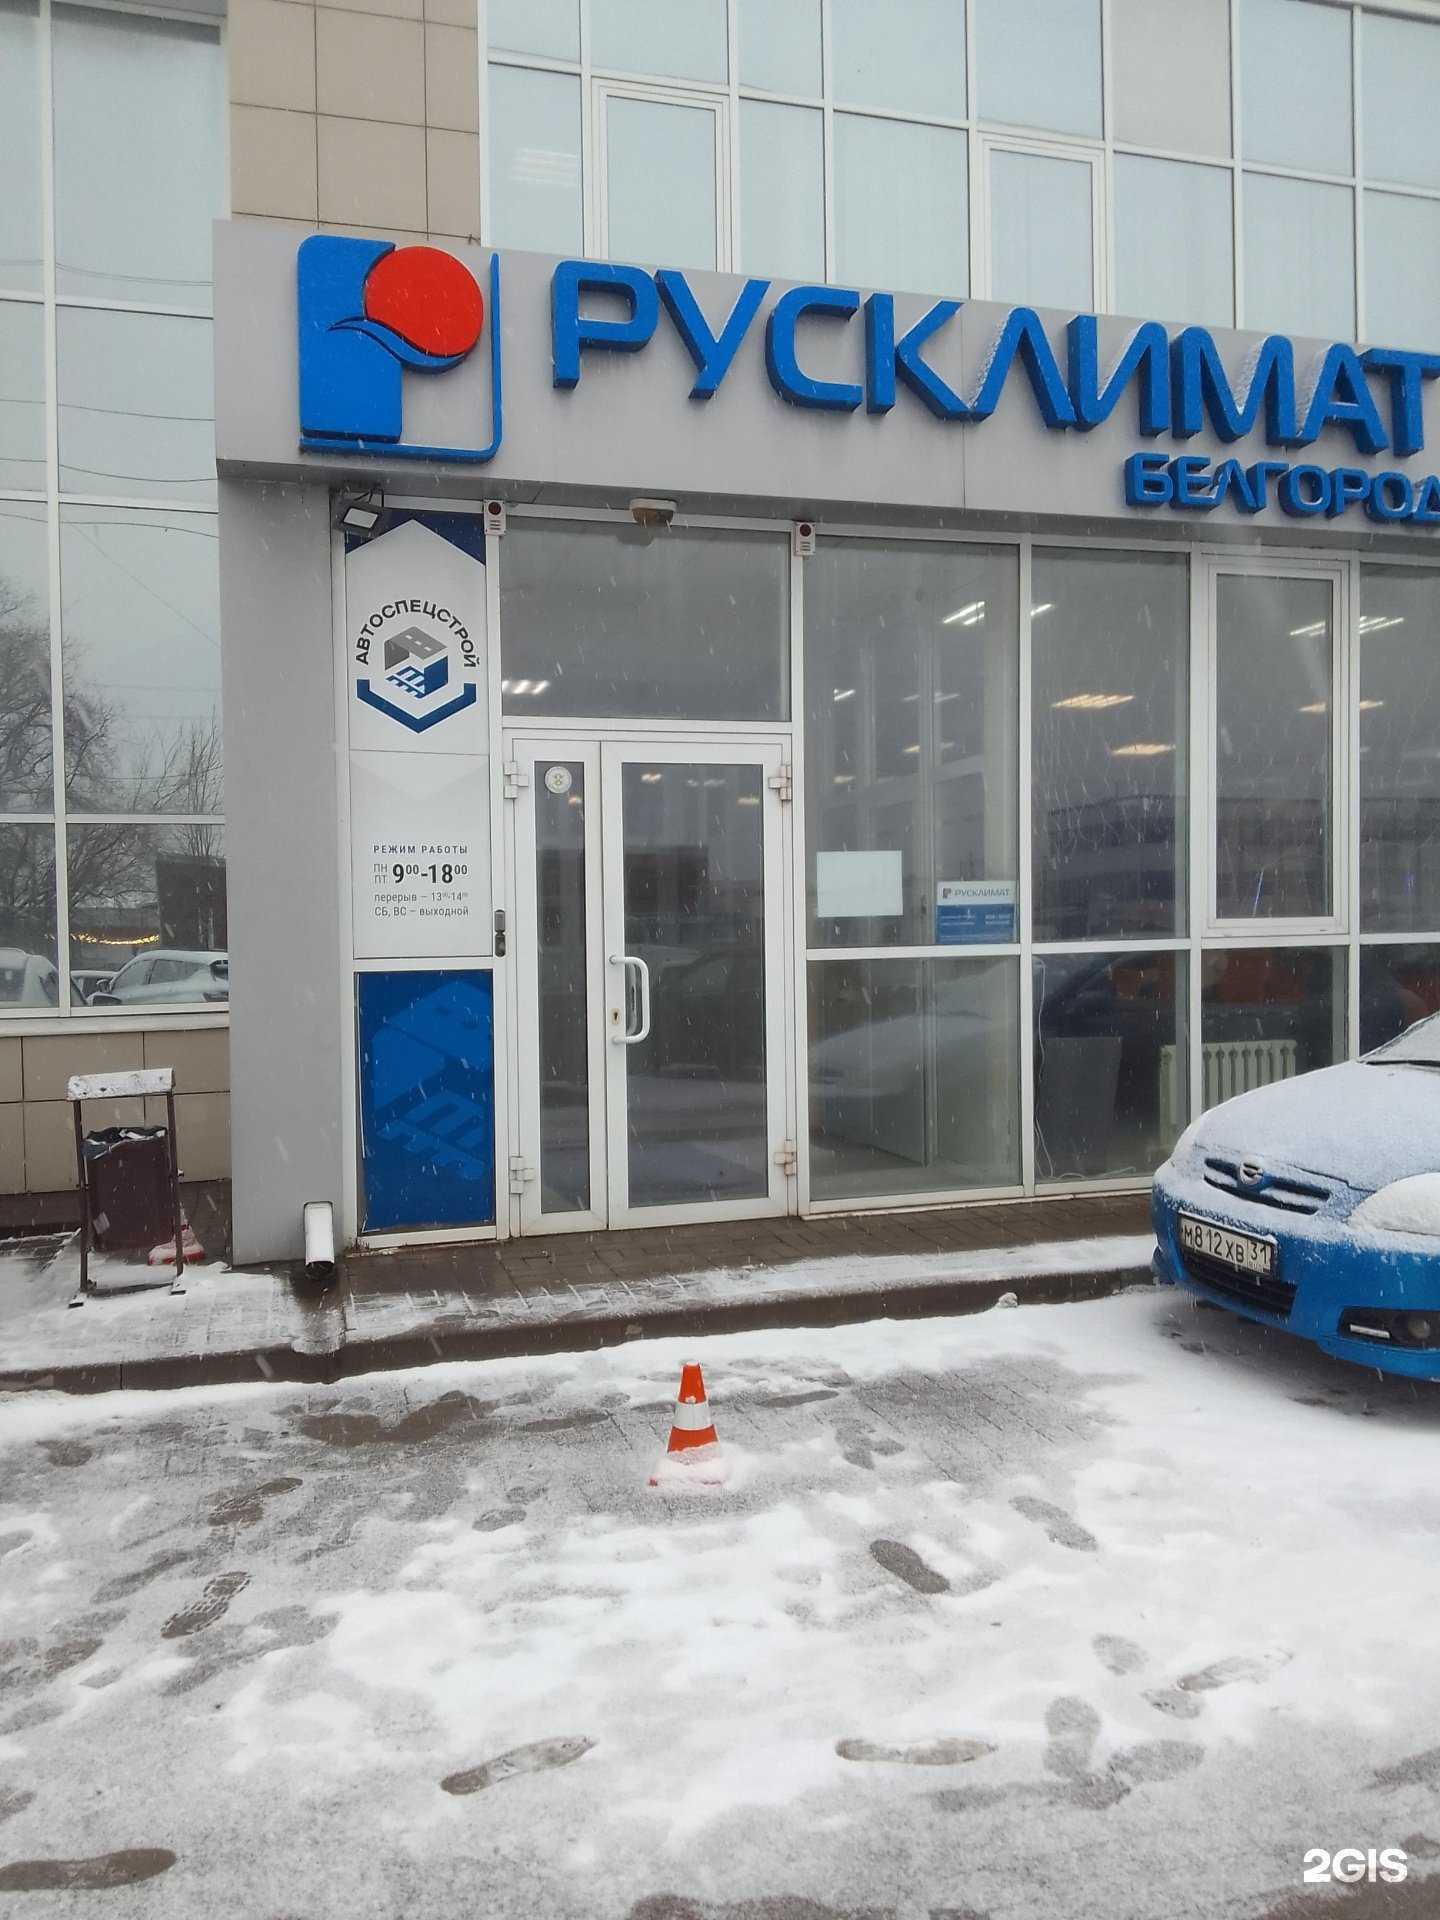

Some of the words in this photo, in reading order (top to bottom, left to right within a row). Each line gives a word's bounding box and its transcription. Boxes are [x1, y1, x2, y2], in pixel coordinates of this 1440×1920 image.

[551, 259, 1440, 457] РУСКЛИМАТ
[355, 599, 480, 668] АВТОСПЕЦСТРОЙ
[373, 845, 416, 854] РЕЖИМ
[421, 845, 468, 854] РАБОТЫ
[373, 863, 388, 873] ПН
[374, 874, 387, 884] ПТ
[374, 893, 417, 903] перерыв
[374, 906, 391, 917] СБ,
[393, 906, 407, 916] ВС
[419, 906, 469, 917] выходной
